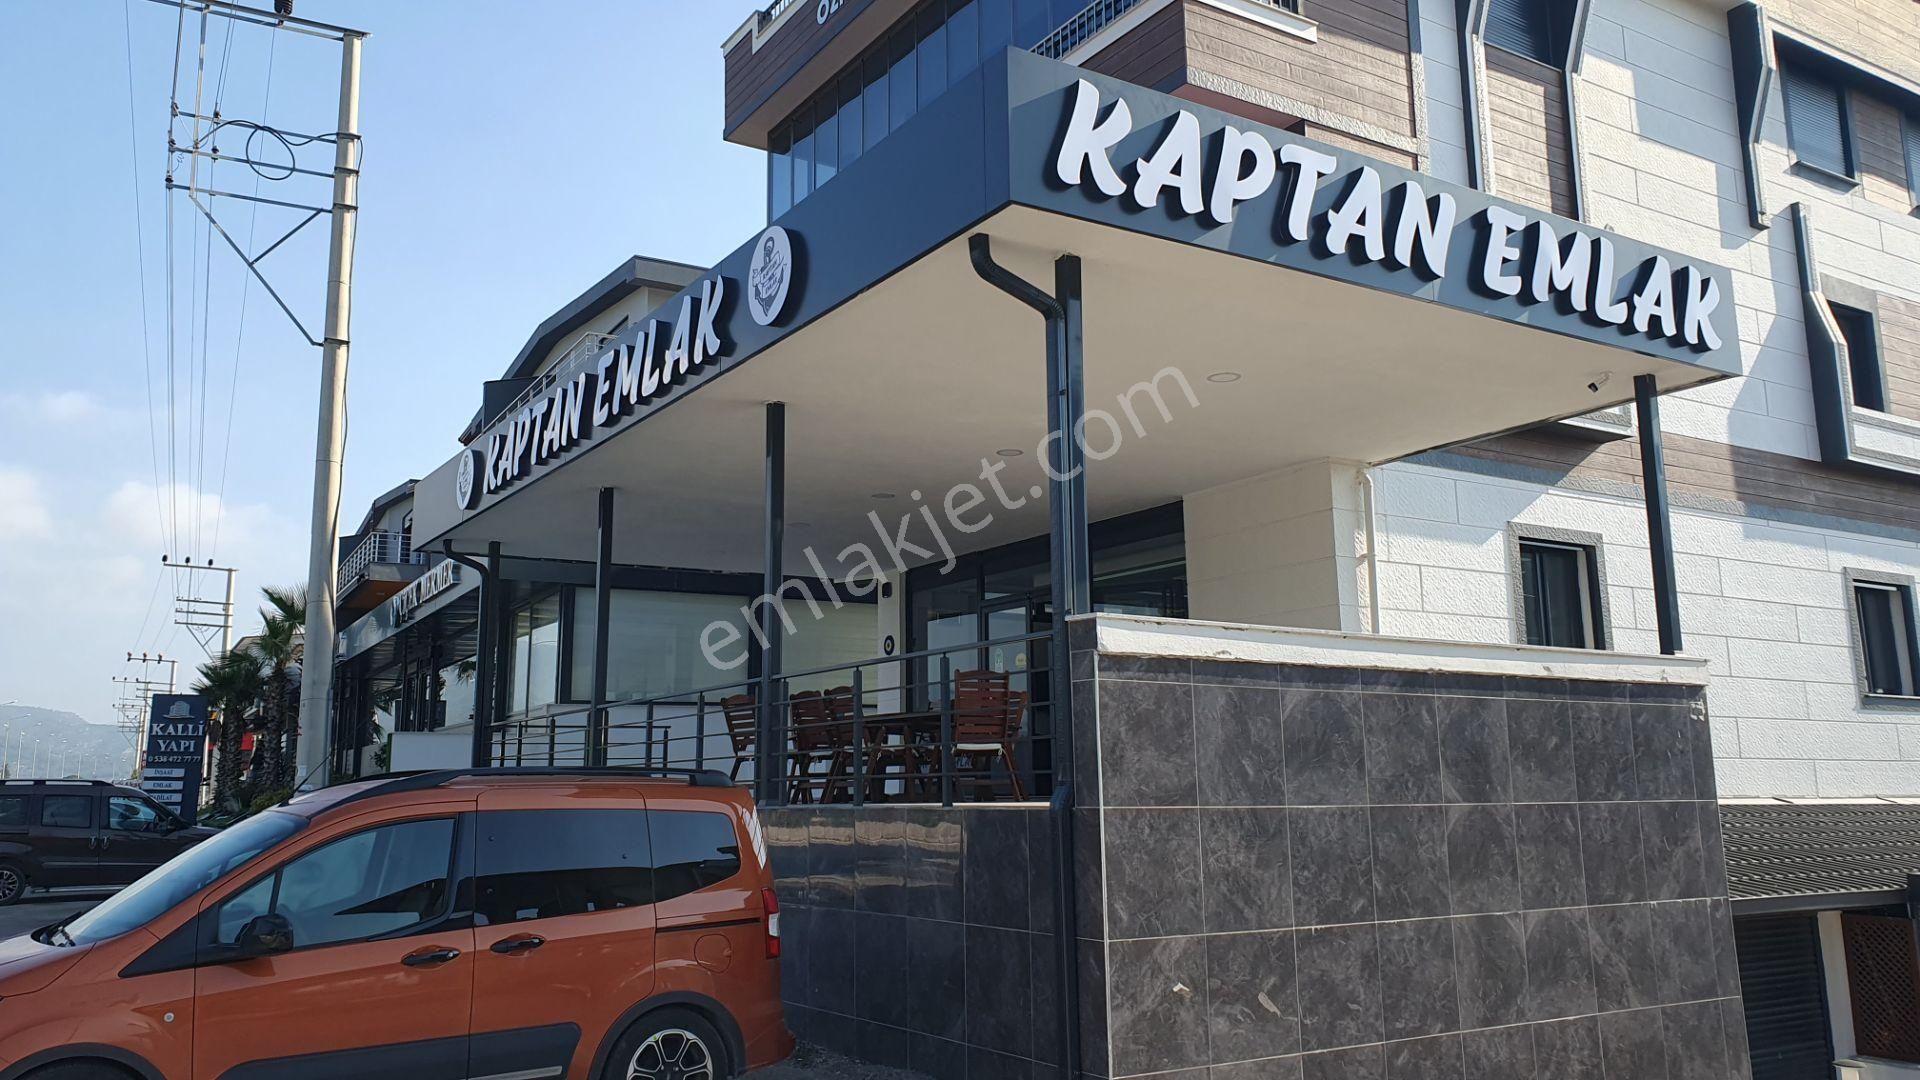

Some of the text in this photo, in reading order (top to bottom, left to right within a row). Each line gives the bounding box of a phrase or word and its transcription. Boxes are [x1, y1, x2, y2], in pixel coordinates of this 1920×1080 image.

[1056, 78, 1722, 351] KAPTAN EMLAK
[483, 274, 724, 495] KAPTAN EMLAK
[150, 721, 205, 736] KALLİ
[157, 740, 195, 752] YAPI
